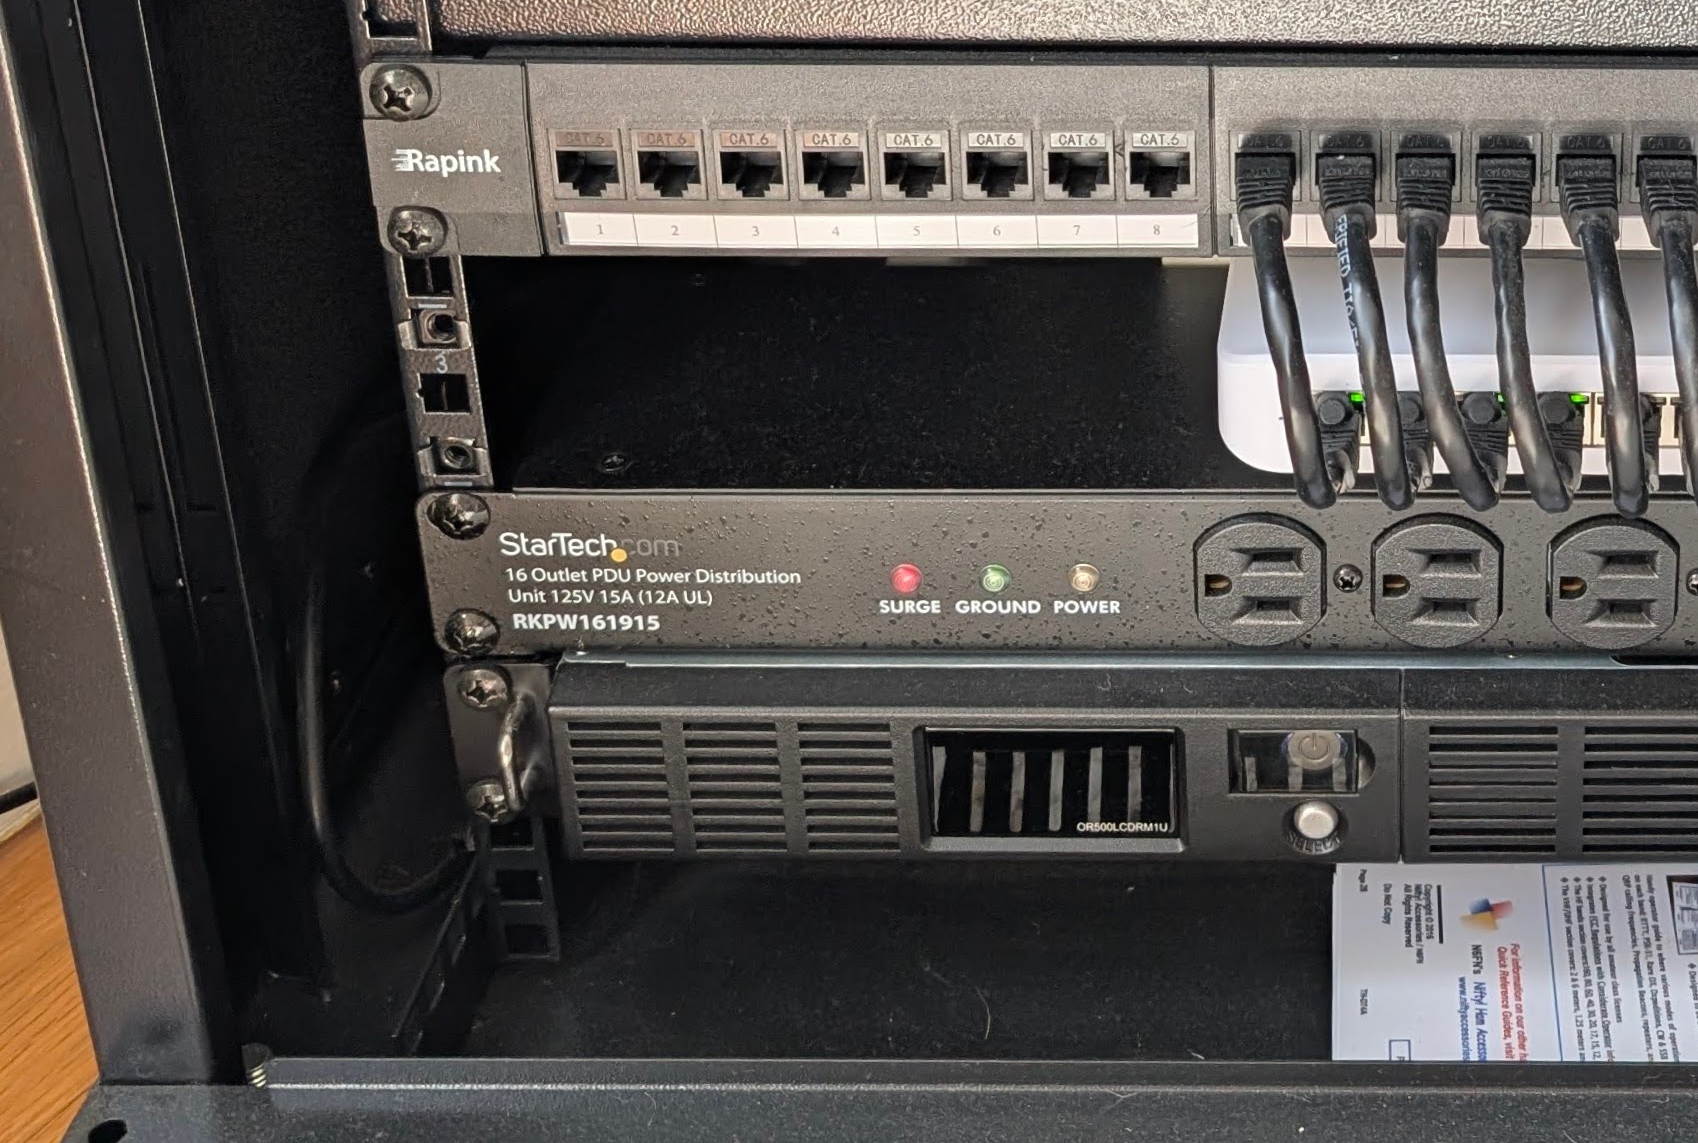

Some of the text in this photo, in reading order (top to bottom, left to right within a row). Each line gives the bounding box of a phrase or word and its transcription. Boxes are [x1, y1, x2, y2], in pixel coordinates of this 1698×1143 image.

[646, 132, 687, 146] CAT.6
[728, 133, 769, 147] CAT.6
[811, 133, 852, 147] CAT.6
[893, 133, 934, 147] CAT.6
[975, 133, 1016, 147] CAT.6
[1058, 133, 1099, 147] CAT.6
[1140, 132, 1180, 146] CAT.6
[398, 148, 501, 176] Rapink
[597, 224, 605, 235] 1
[671, 225, 679, 236] 2
[751, 225, 760, 237] 3
[831, 225, 840, 237] 4
[913, 225, 920, 236] 5
[993, 225, 1001, 236] 6
[1073, 225, 1081, 236] 7
[1152, 224, 1160, 236] 8
[1334, 214, 1352, 277] ERIFIED
[436, 351, 448, 374] 3
[499, 531, 680, 563] StarTech.com
[505, 567, 802, 585] 16 Outlet PDU Power Distribution
[508, 588, 713, 607] Unit 125V 15A (12A UL)
[879, 599, 1120, 615] SURGE GROUND POWER
[512, 612, 661, 631] RKPW161915
[1076, 821, 1169, 834] OR500LCDRM1U
[1287, 832, 1341, 856] SELECT
[1359, 869, 1367, 883] Page
[1382, 884, 1393, 924] Do Not Copy
[1402, 894, 1411, 915] Rights
[1423, 884, 1432, 915] Copyright
[1415, 903, 1423, 943] Accessories
[1405, 917, 1413, 947] Reserved
[1511, 944, 1520, 956] For
[1472, 945, 1483, 974] N6FN's
[1511, 958, 1523, 1001] information
[1498, 947, 1514, 1059] Quick Reference Guides, visit
[1516, 1004, 1523, 1013] on
[1475, 1008, 1487, 1025] Ham
[1517, 1031, 1527, 1051] other
